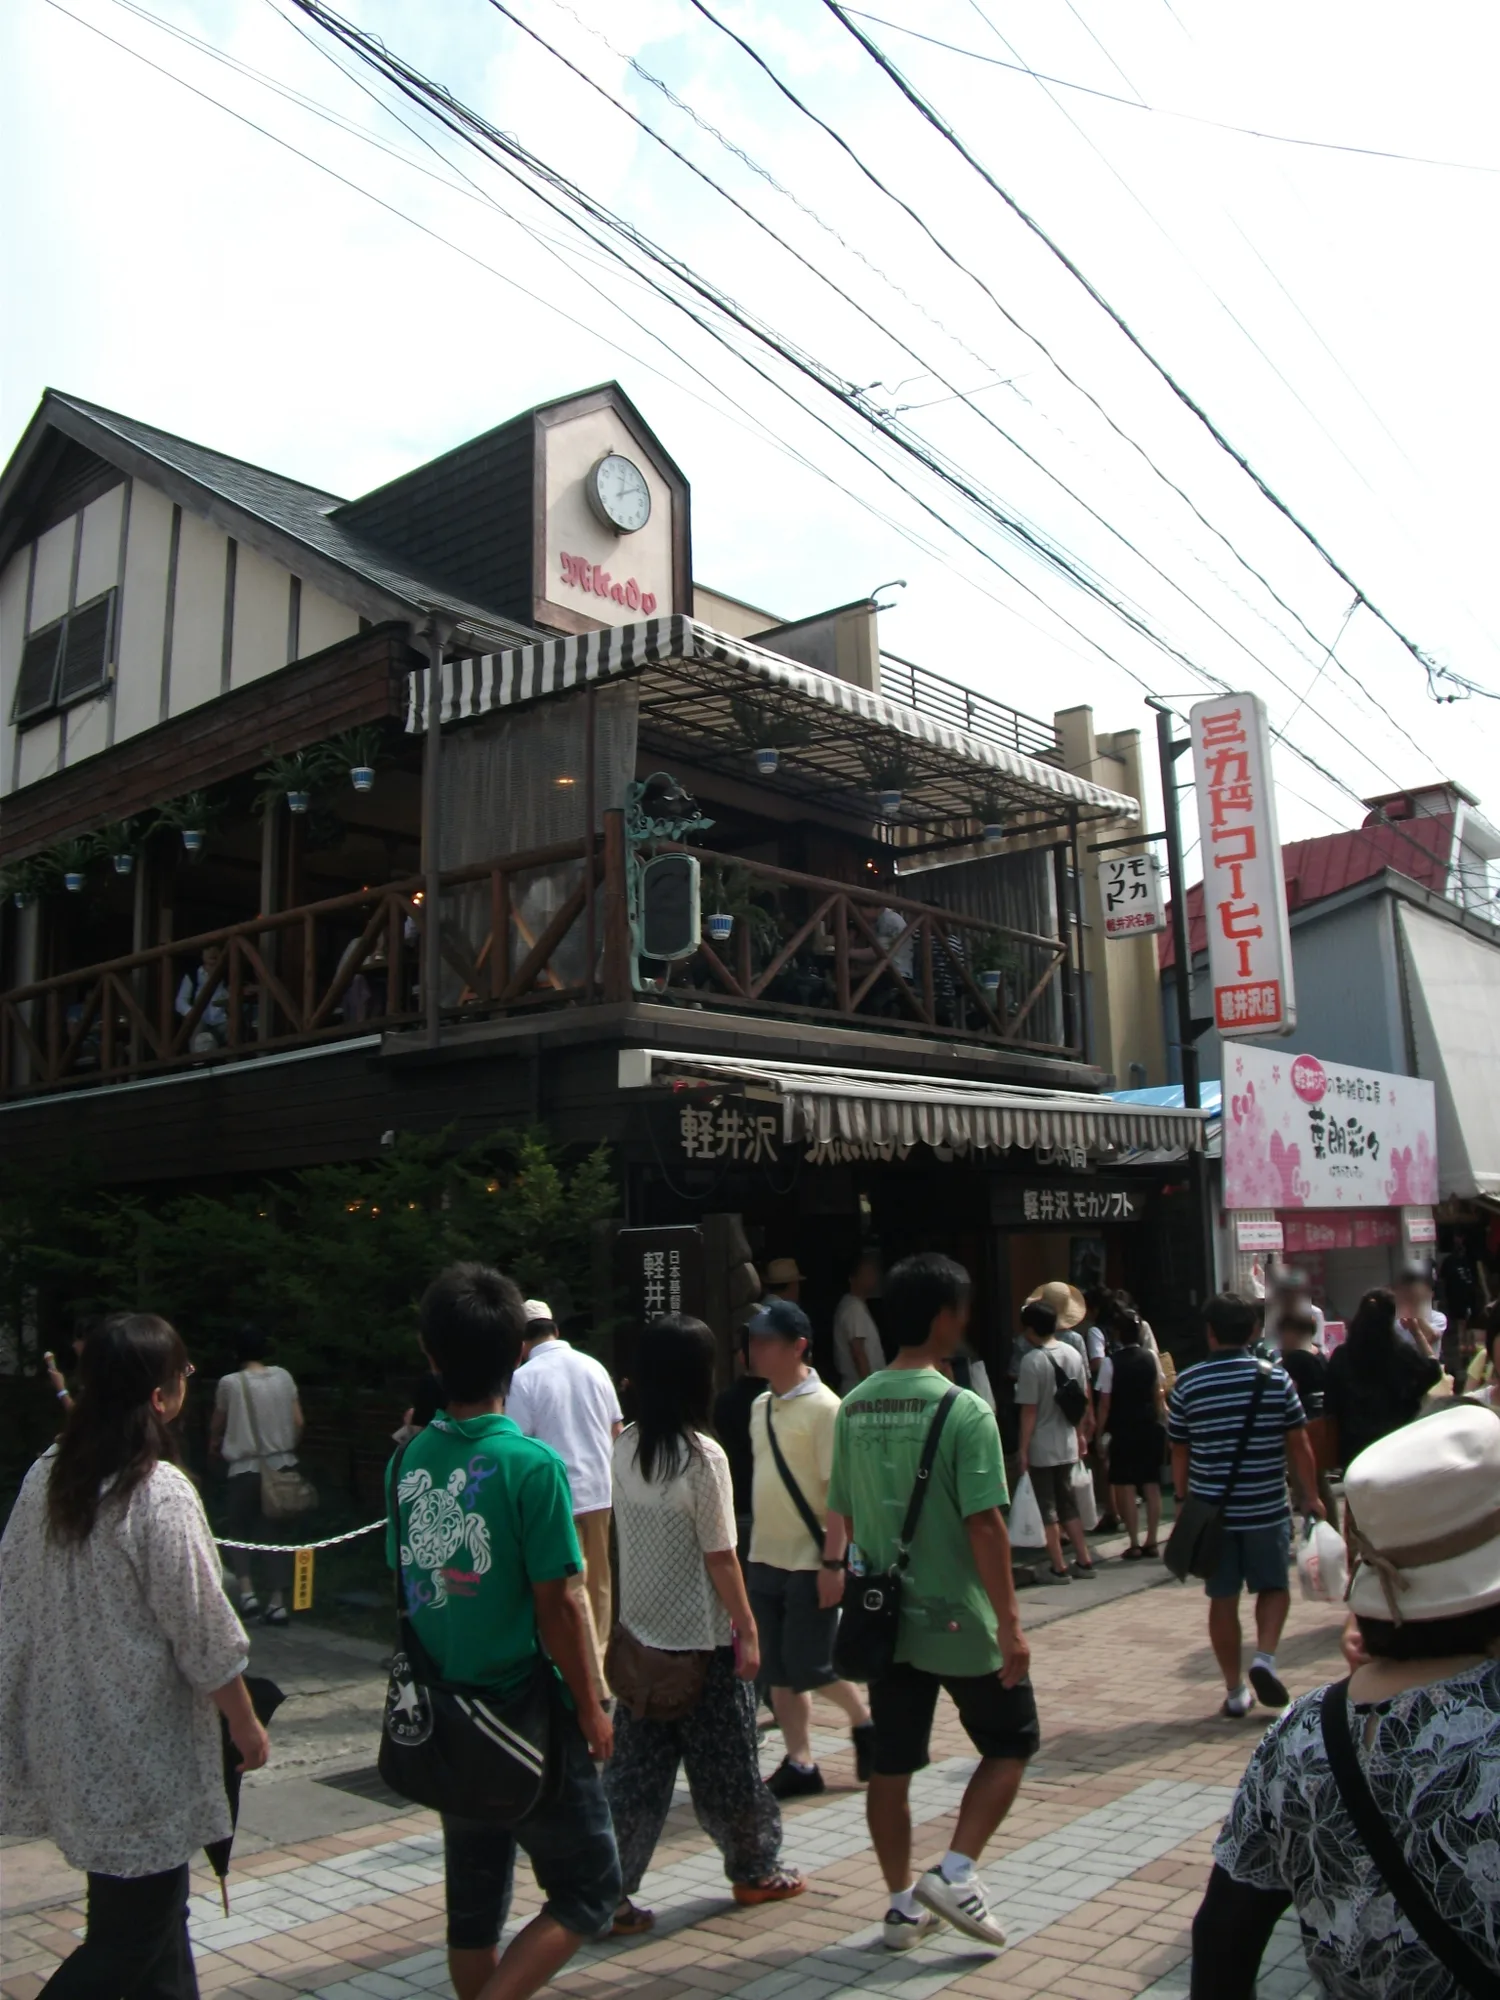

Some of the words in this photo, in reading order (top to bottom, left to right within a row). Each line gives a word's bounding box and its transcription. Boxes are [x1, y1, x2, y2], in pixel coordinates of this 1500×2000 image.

[560, 552, 657, 615] Mikado
[1201, 708, 1263, 977] ミカドコーヒー
[1107, 863, 1125, 911] ソフト
[1128, 859, 1147, 899] モカ
[1221, 986, 1276, 1020] 軽井沢店
[680, 1104, 778, 1163] 軽井沢
[1023, 1190, 1070, 1220] 軽井沢
[1073, 1192, 1134, 1218] モカソフト
